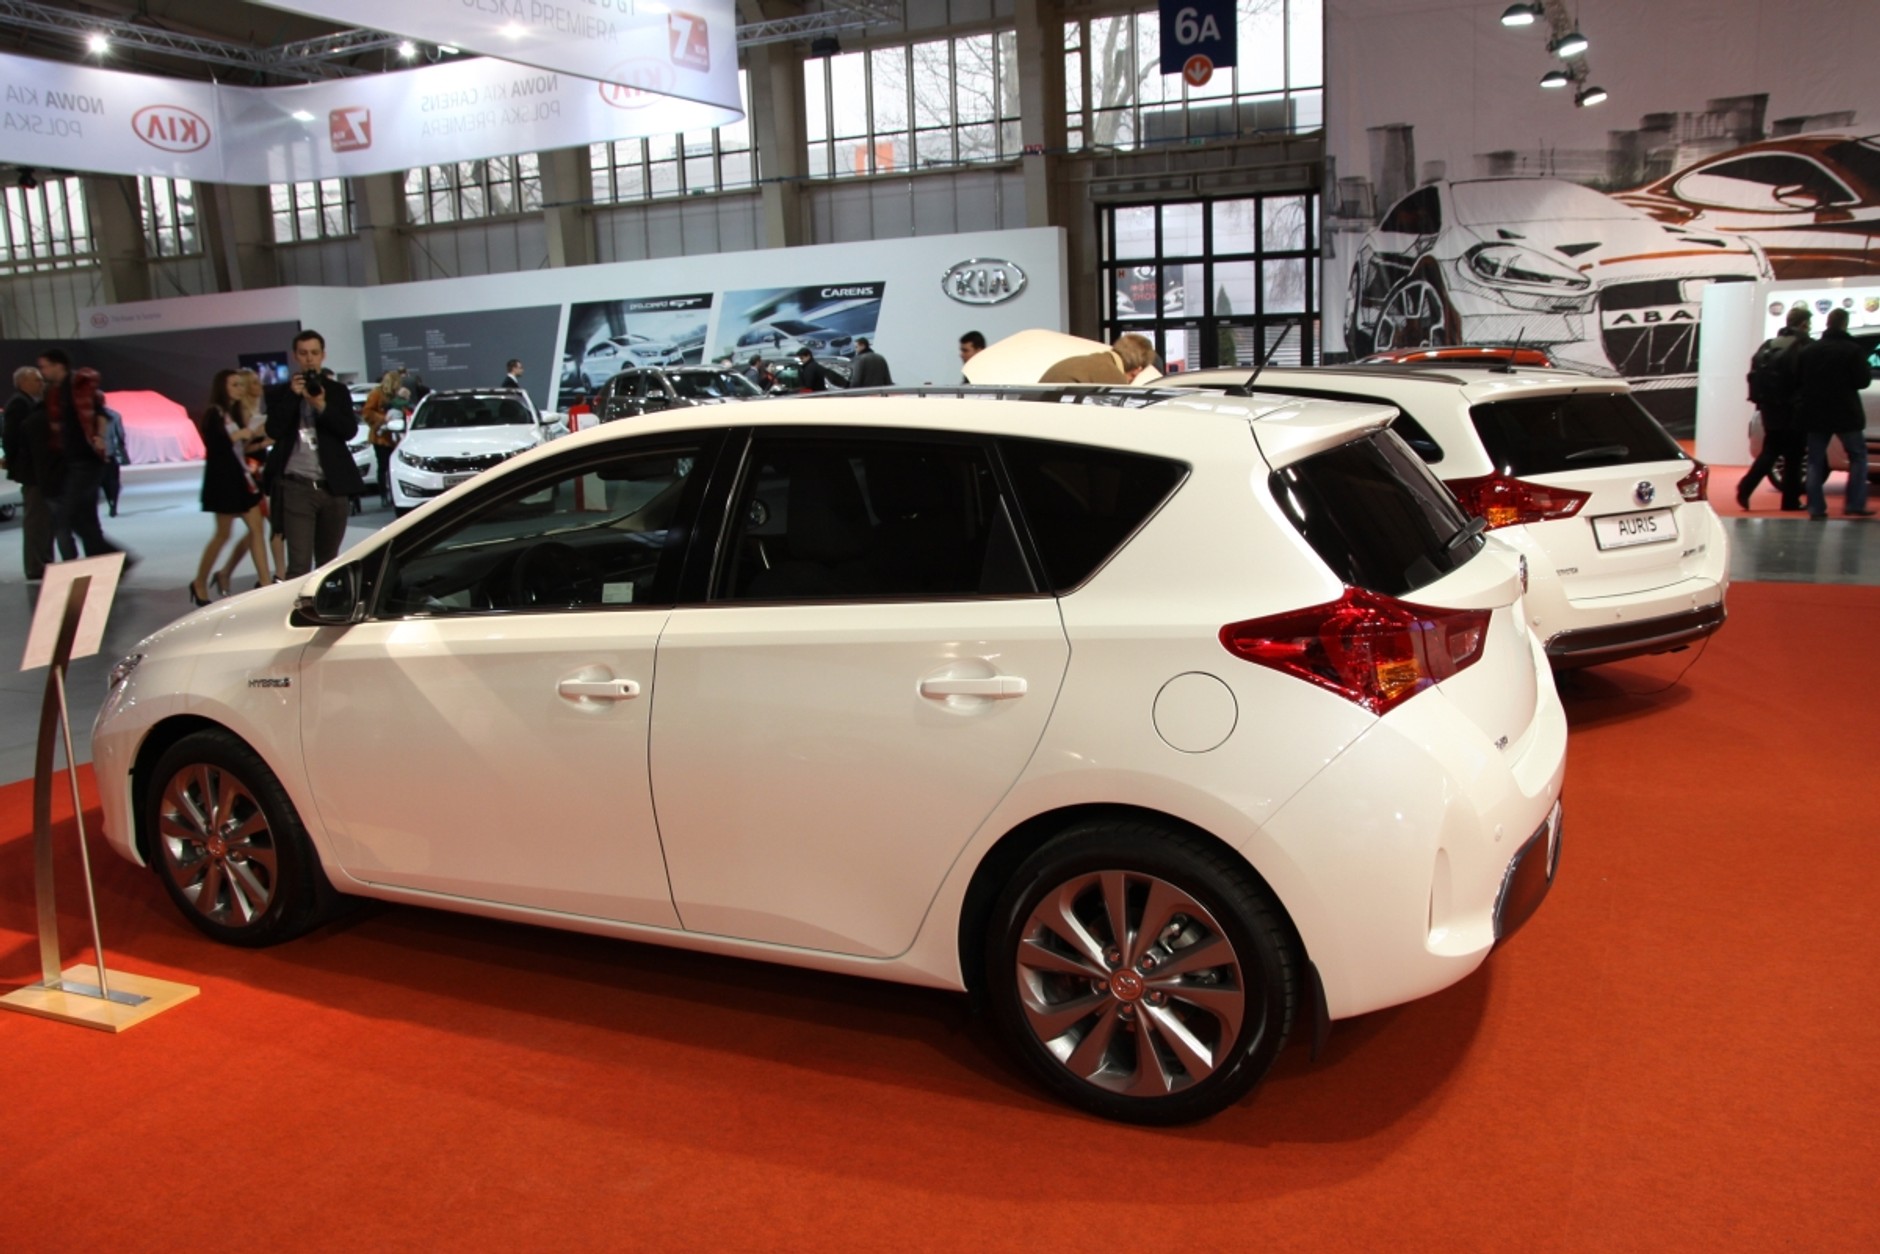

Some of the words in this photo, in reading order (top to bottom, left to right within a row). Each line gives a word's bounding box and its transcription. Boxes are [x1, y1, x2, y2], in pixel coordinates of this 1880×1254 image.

[462, 0, 526, 20] LSKA
[531, 1, 618, 43] PREMIERA
[1175, 7, 1221, 45] 6A
[821, 287, 874, 298] CARENS
[954, 269, 1011, 296] KIA
[1611, 309, 1700, 326] ABA
[1618, 515, 1658, 536] AURIS
